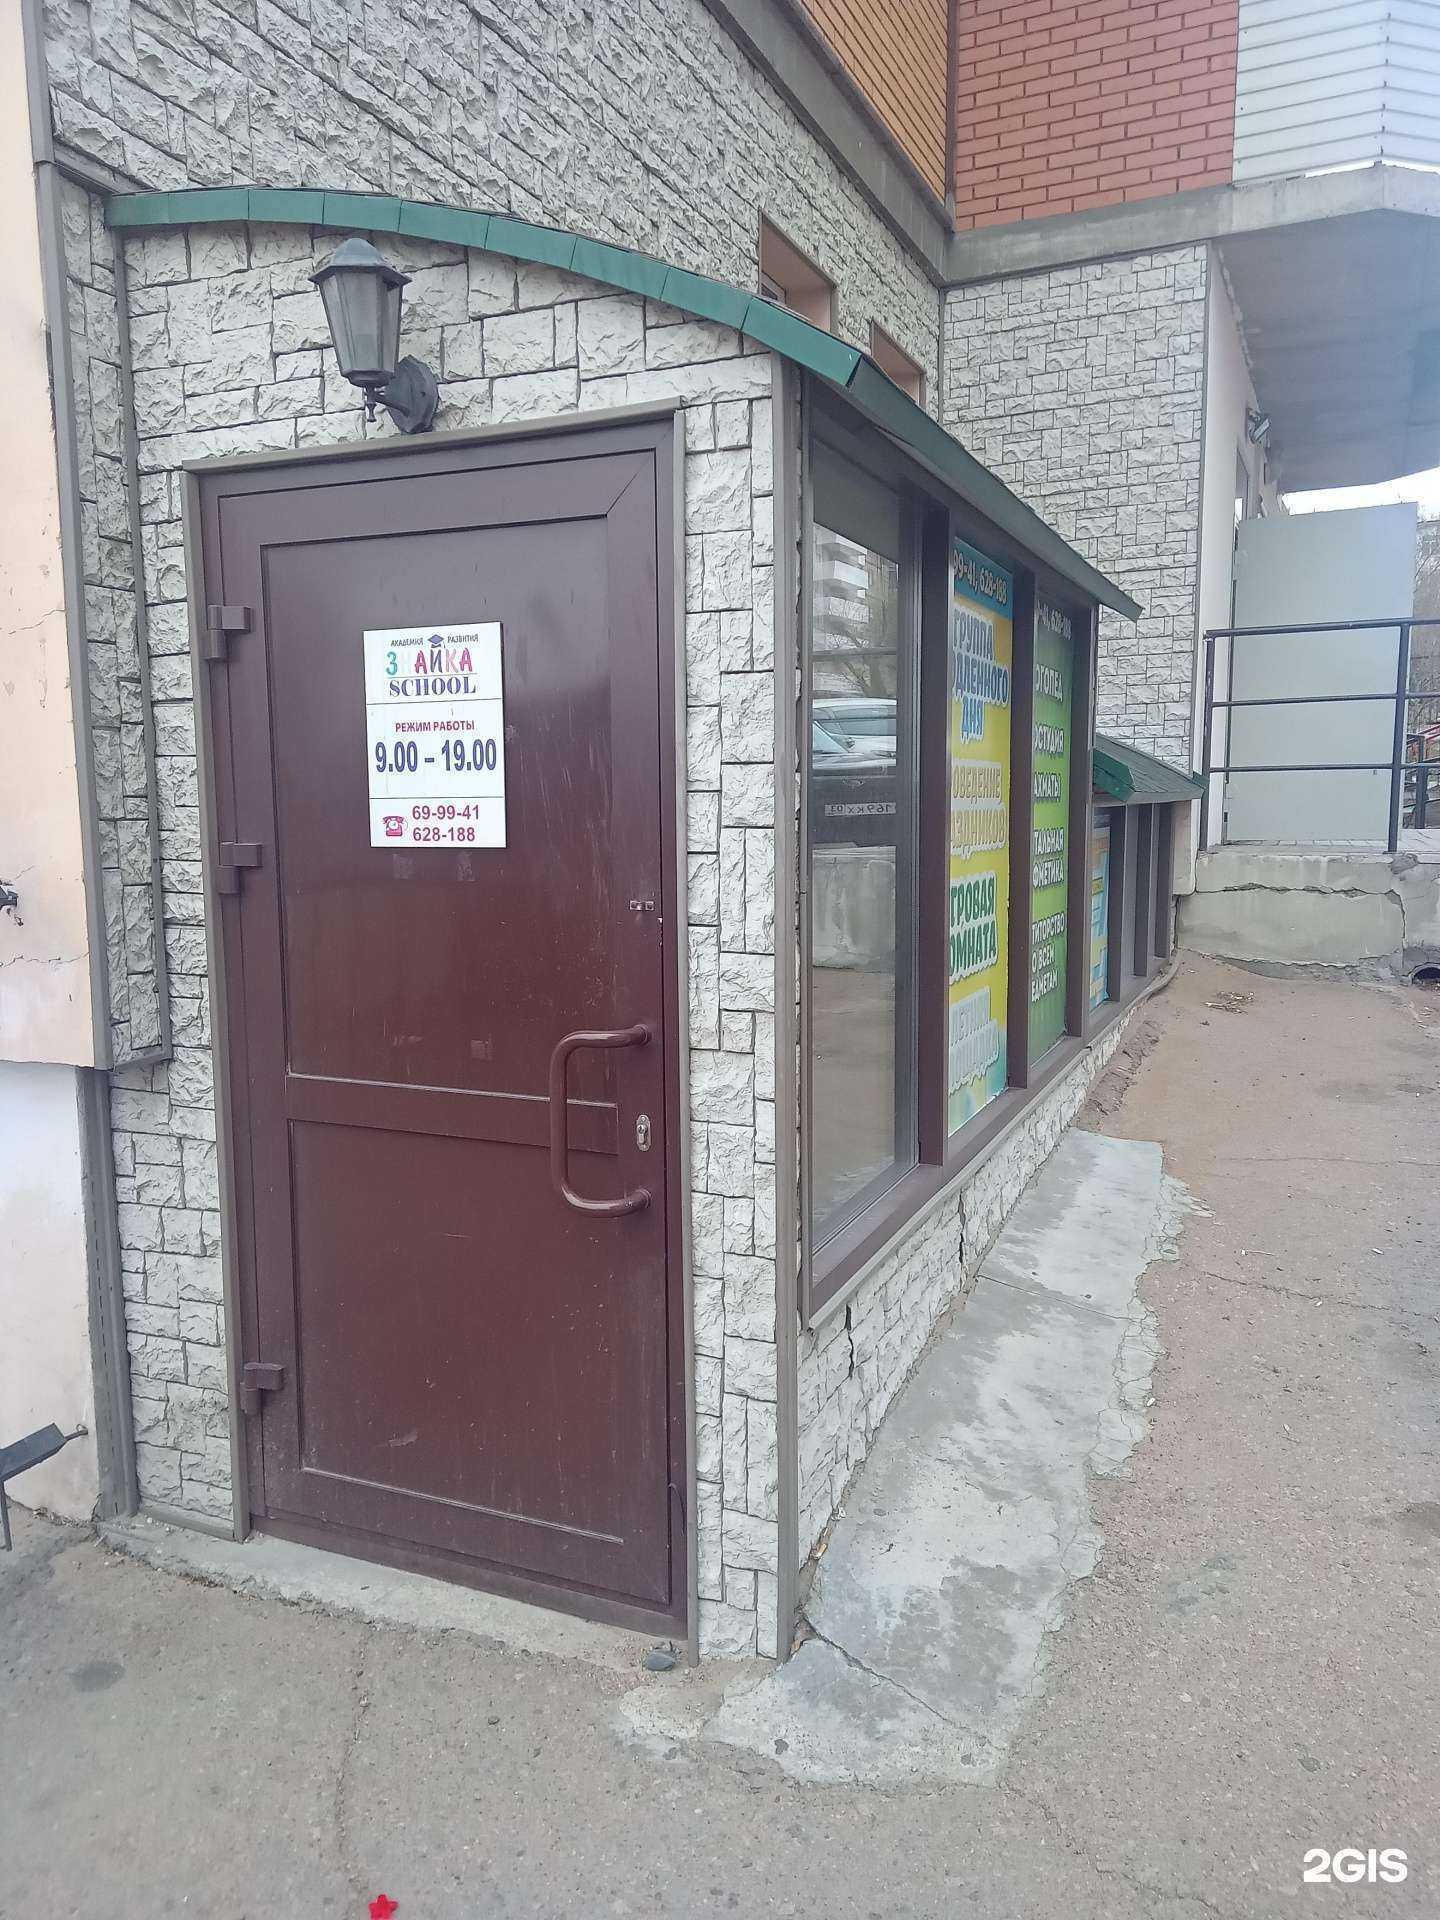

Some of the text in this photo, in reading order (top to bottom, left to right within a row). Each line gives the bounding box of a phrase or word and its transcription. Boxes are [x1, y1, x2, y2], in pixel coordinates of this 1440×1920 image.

[447, 633, 479, 643] РАЗВИТИЯ
[953, 608, 993, 660] ГРУППА
[386, 644, 473, 676] ЗАЙКА
[389, 676, 476, 698] SCHOOL
[395, 720, 475, 733] РЕЖИМ РАБОТЫ
[961, 696, 984, 740] ДНЯ
[375, 741, 418, 773] 9.00
[441, 738, 497, 772] 19.00
[412, 804, 480, 820] 69-99-41
[412, 827, 476, 842] 628-188
